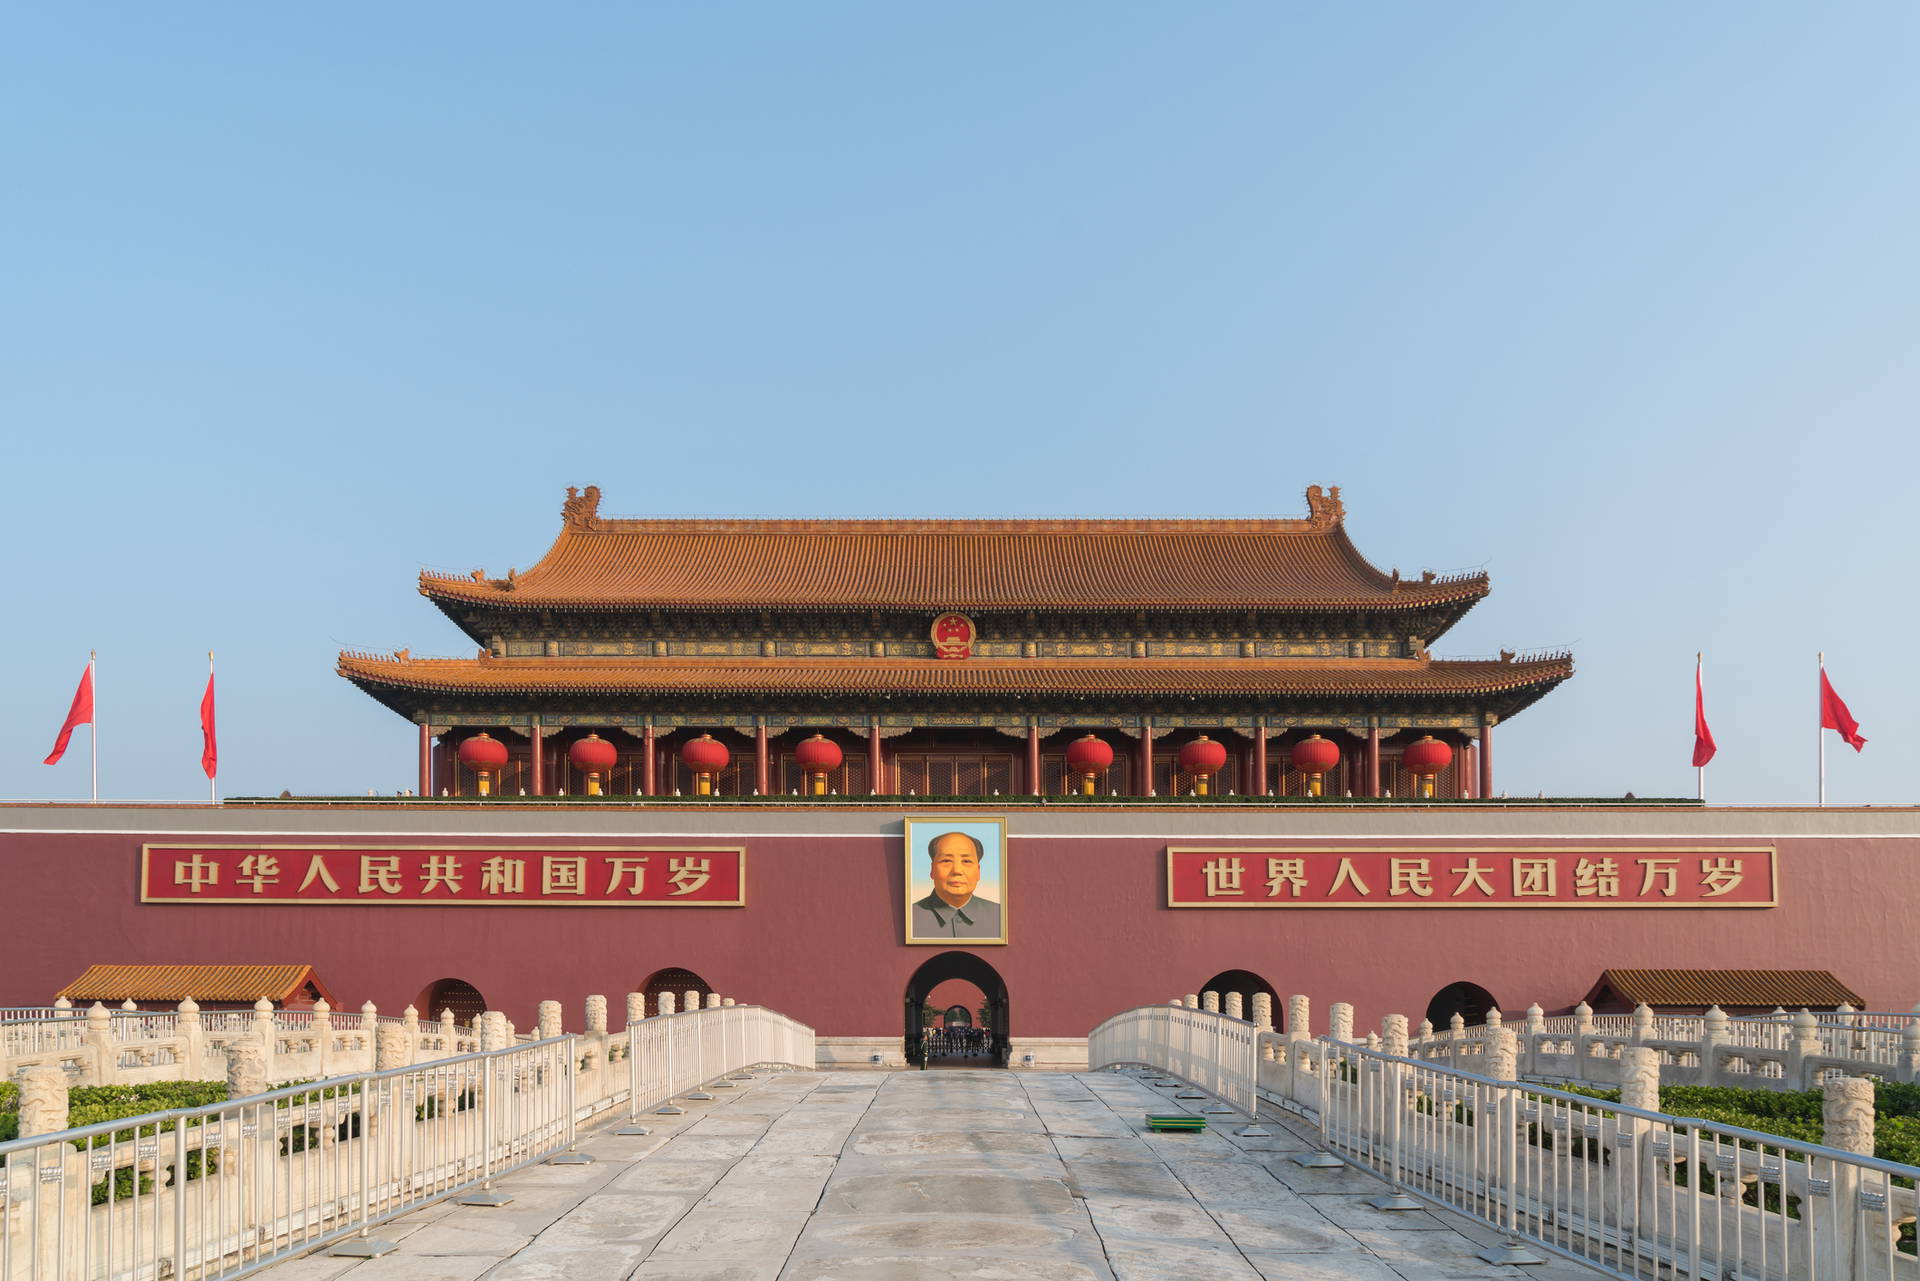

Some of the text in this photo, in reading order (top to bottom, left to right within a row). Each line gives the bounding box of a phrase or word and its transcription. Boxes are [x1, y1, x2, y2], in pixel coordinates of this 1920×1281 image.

[173, 854, 711, 896] 中华人民共和国万岁
[1203, 857, 1745, 897] 世界人民大团结万岁
